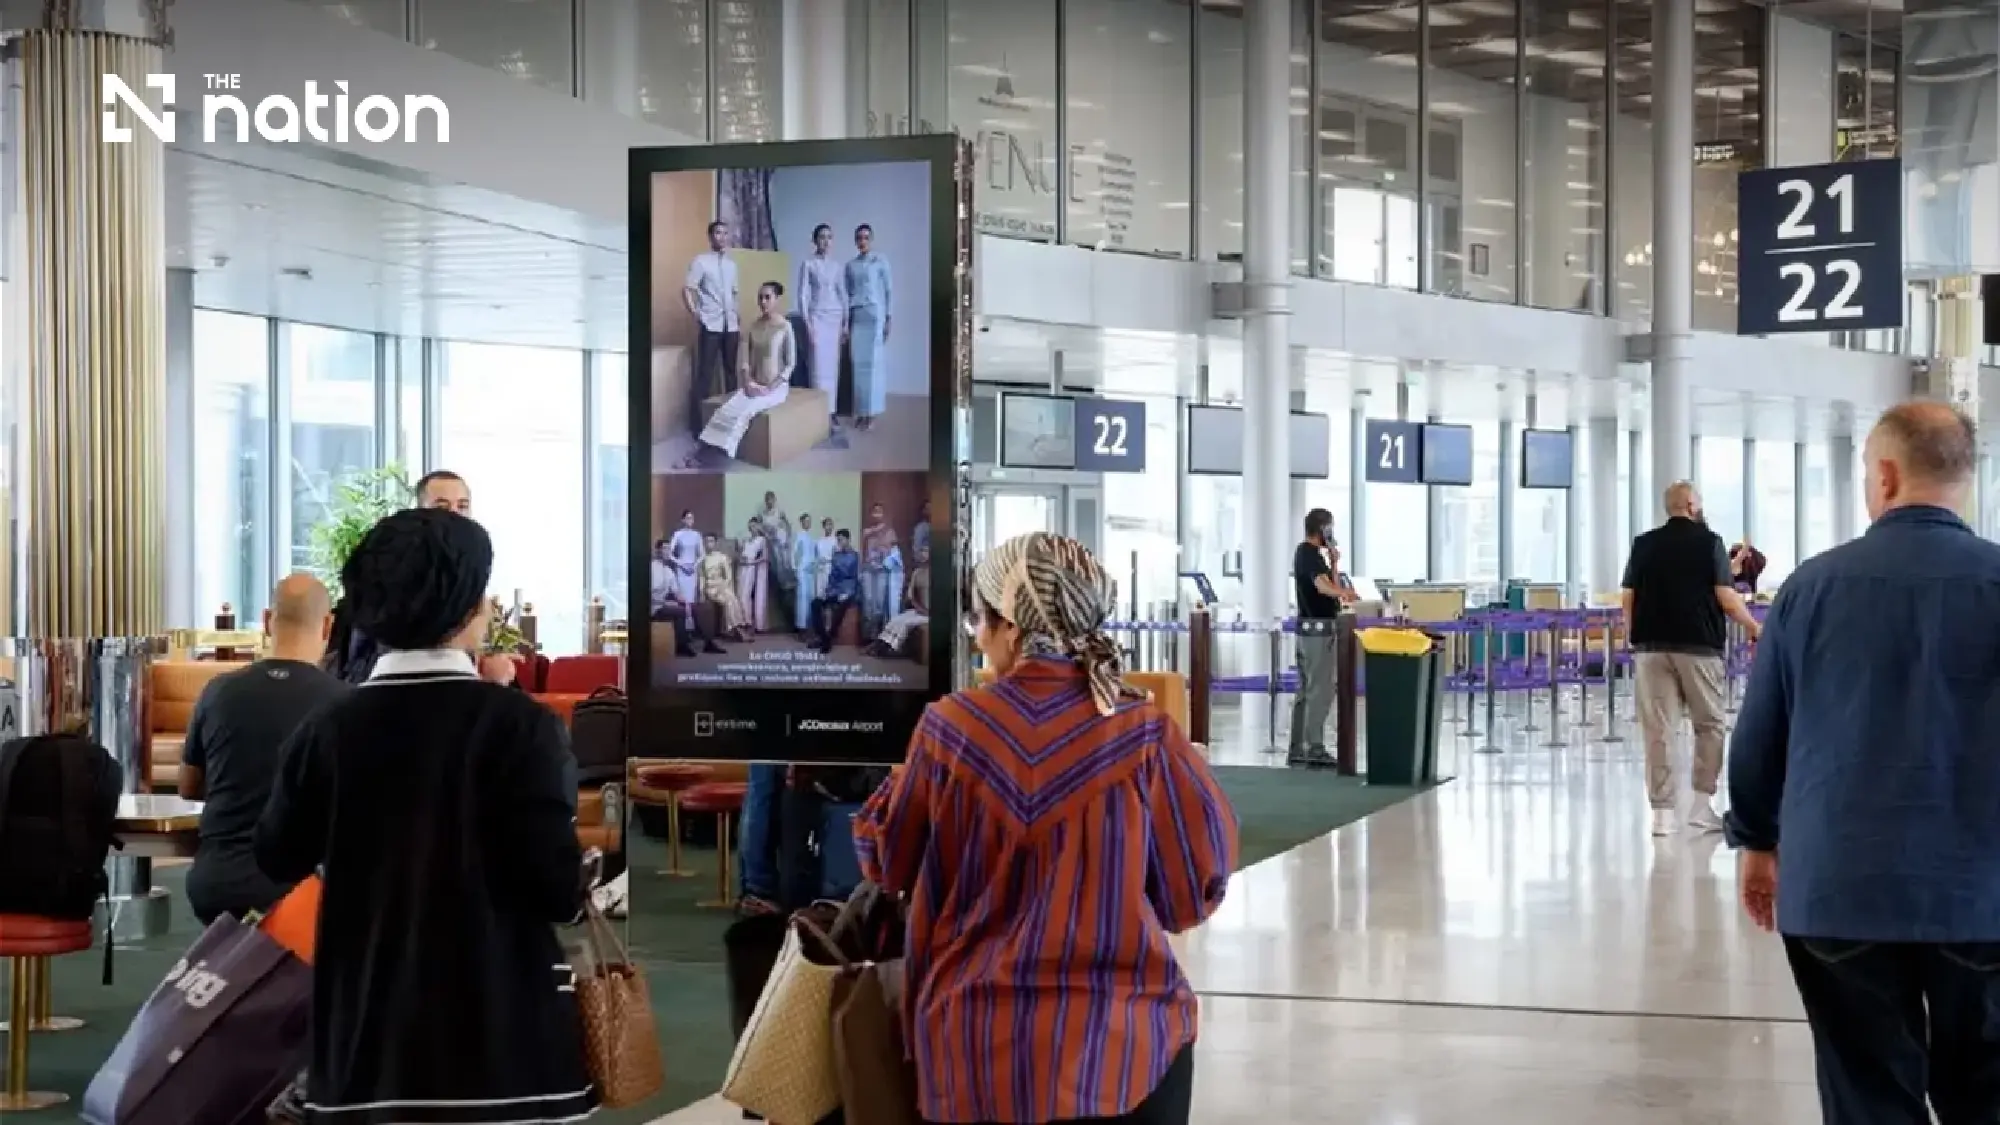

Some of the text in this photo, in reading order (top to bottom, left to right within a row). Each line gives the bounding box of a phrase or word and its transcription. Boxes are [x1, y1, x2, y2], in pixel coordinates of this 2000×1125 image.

[1776, 173, 1855, 240] 21
[1777, 258, 1864, 323] 22
[1093, 415, 1128, 456] 22
[1379, 432, 1404, 469] 21
